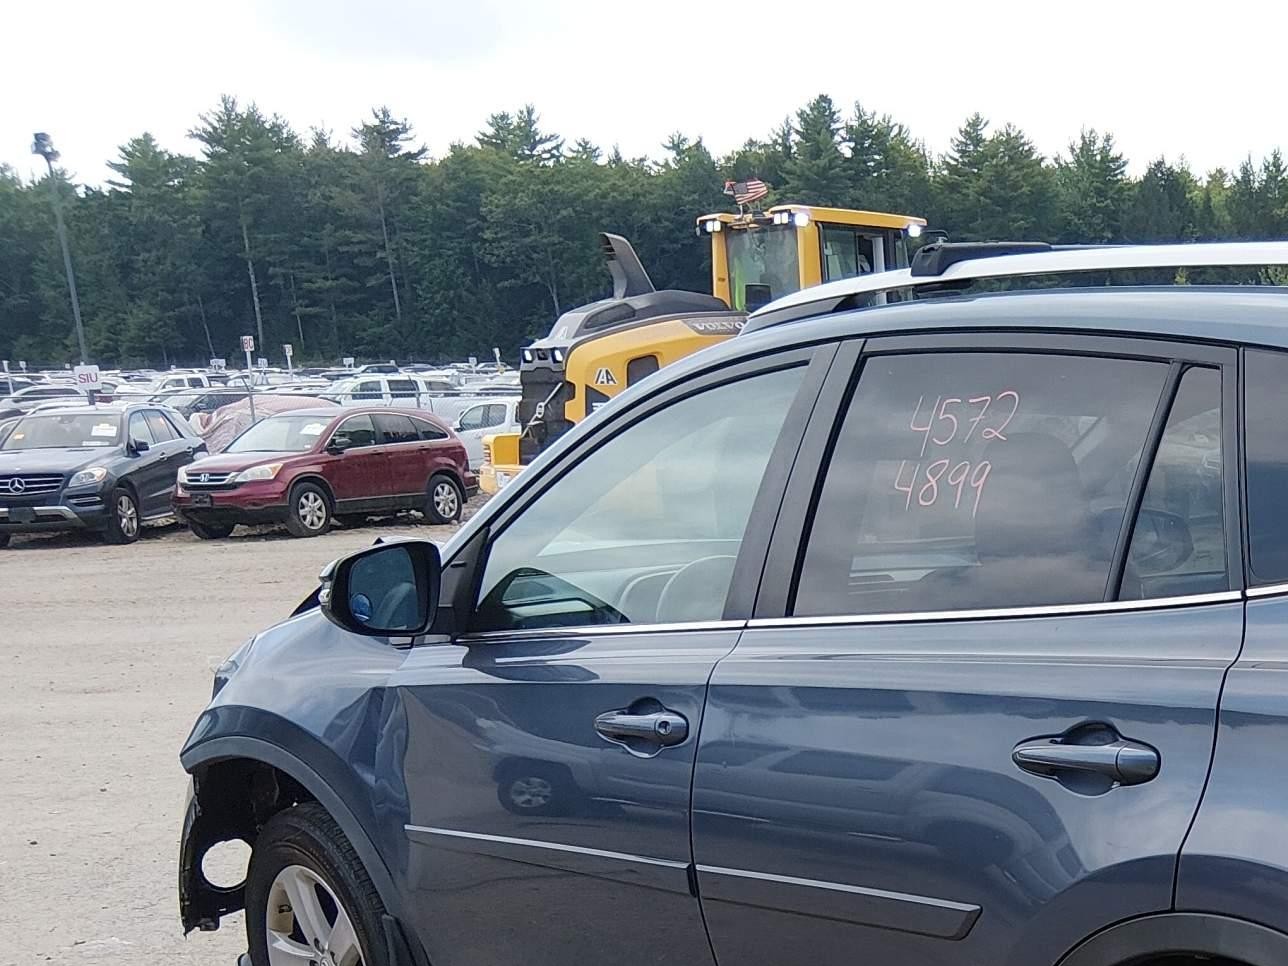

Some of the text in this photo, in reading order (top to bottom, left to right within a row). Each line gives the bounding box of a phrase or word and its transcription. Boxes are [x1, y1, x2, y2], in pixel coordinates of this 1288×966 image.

[693, 321, 745, 331] VOLVO
[909, 390, 1020, 457] 4572
[894, 459, 993, 518] 4899
